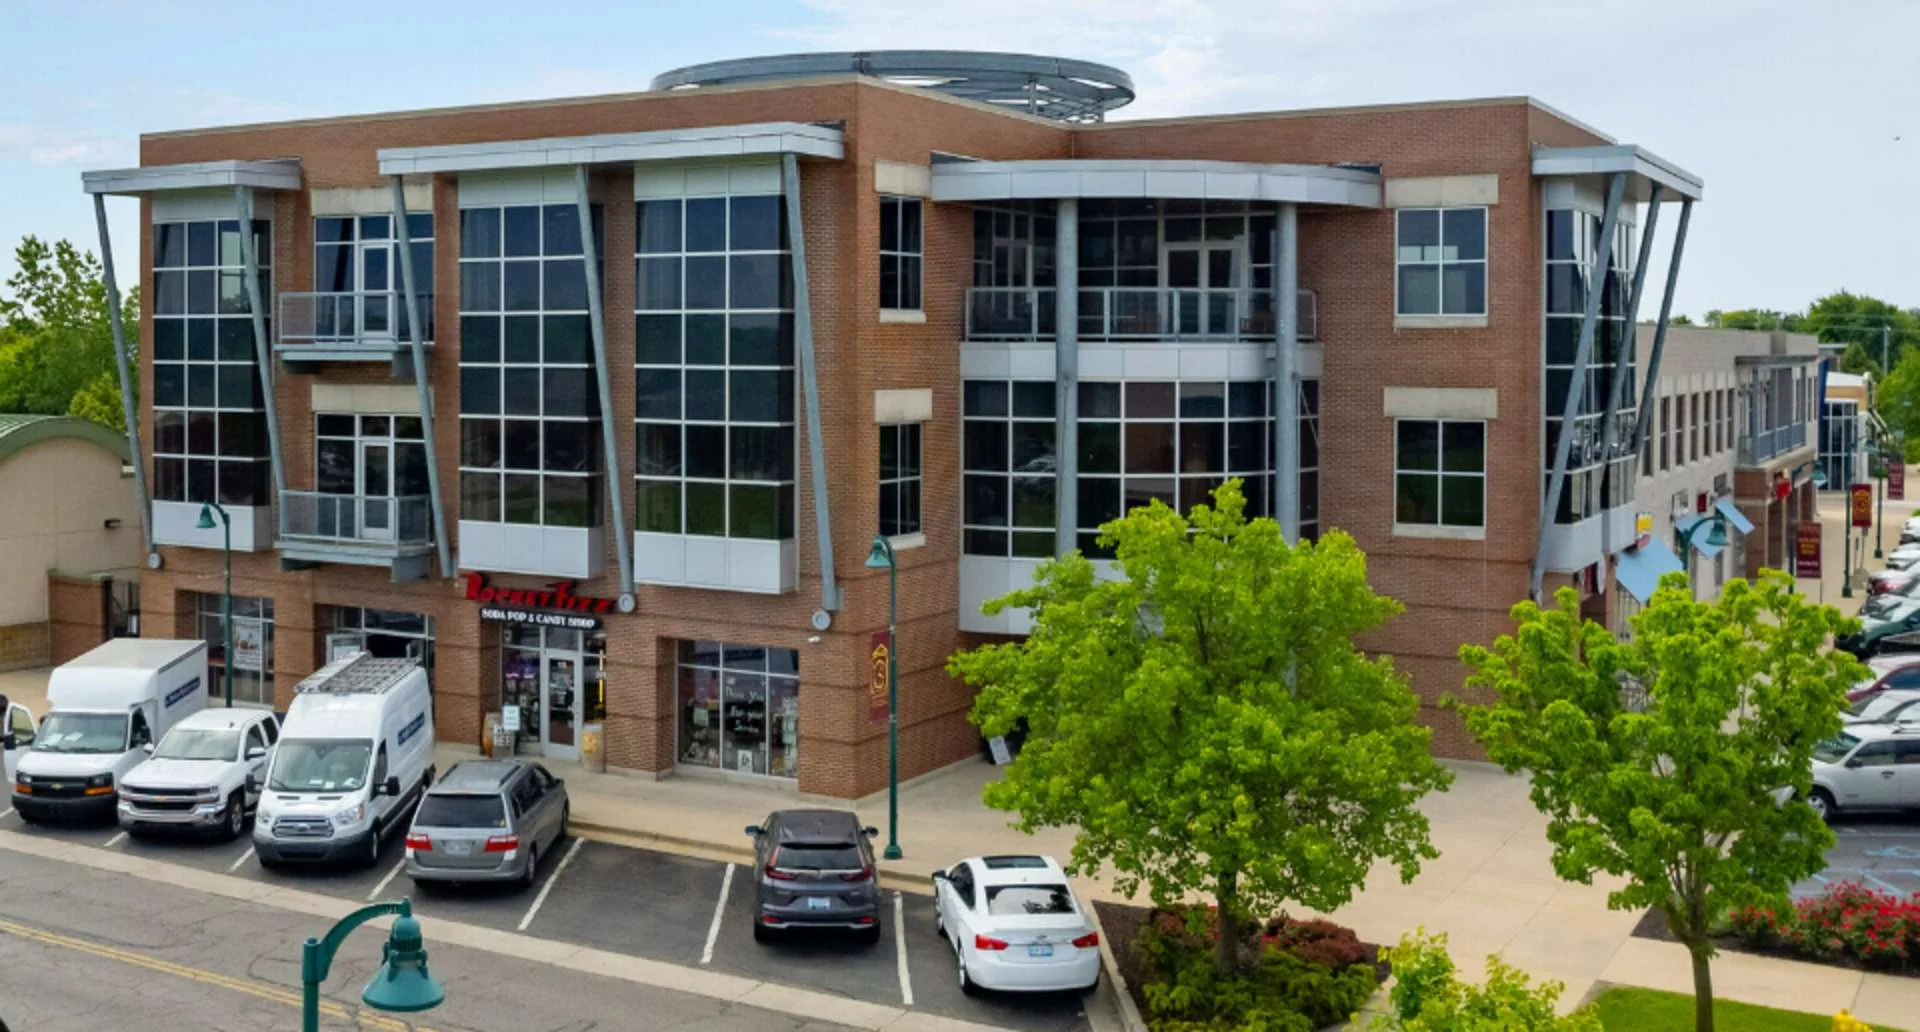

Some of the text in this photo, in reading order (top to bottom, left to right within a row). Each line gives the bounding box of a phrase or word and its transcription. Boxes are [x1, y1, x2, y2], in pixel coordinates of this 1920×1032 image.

[481, 608, 596, 629] SODA POP & CANDY SHOP
